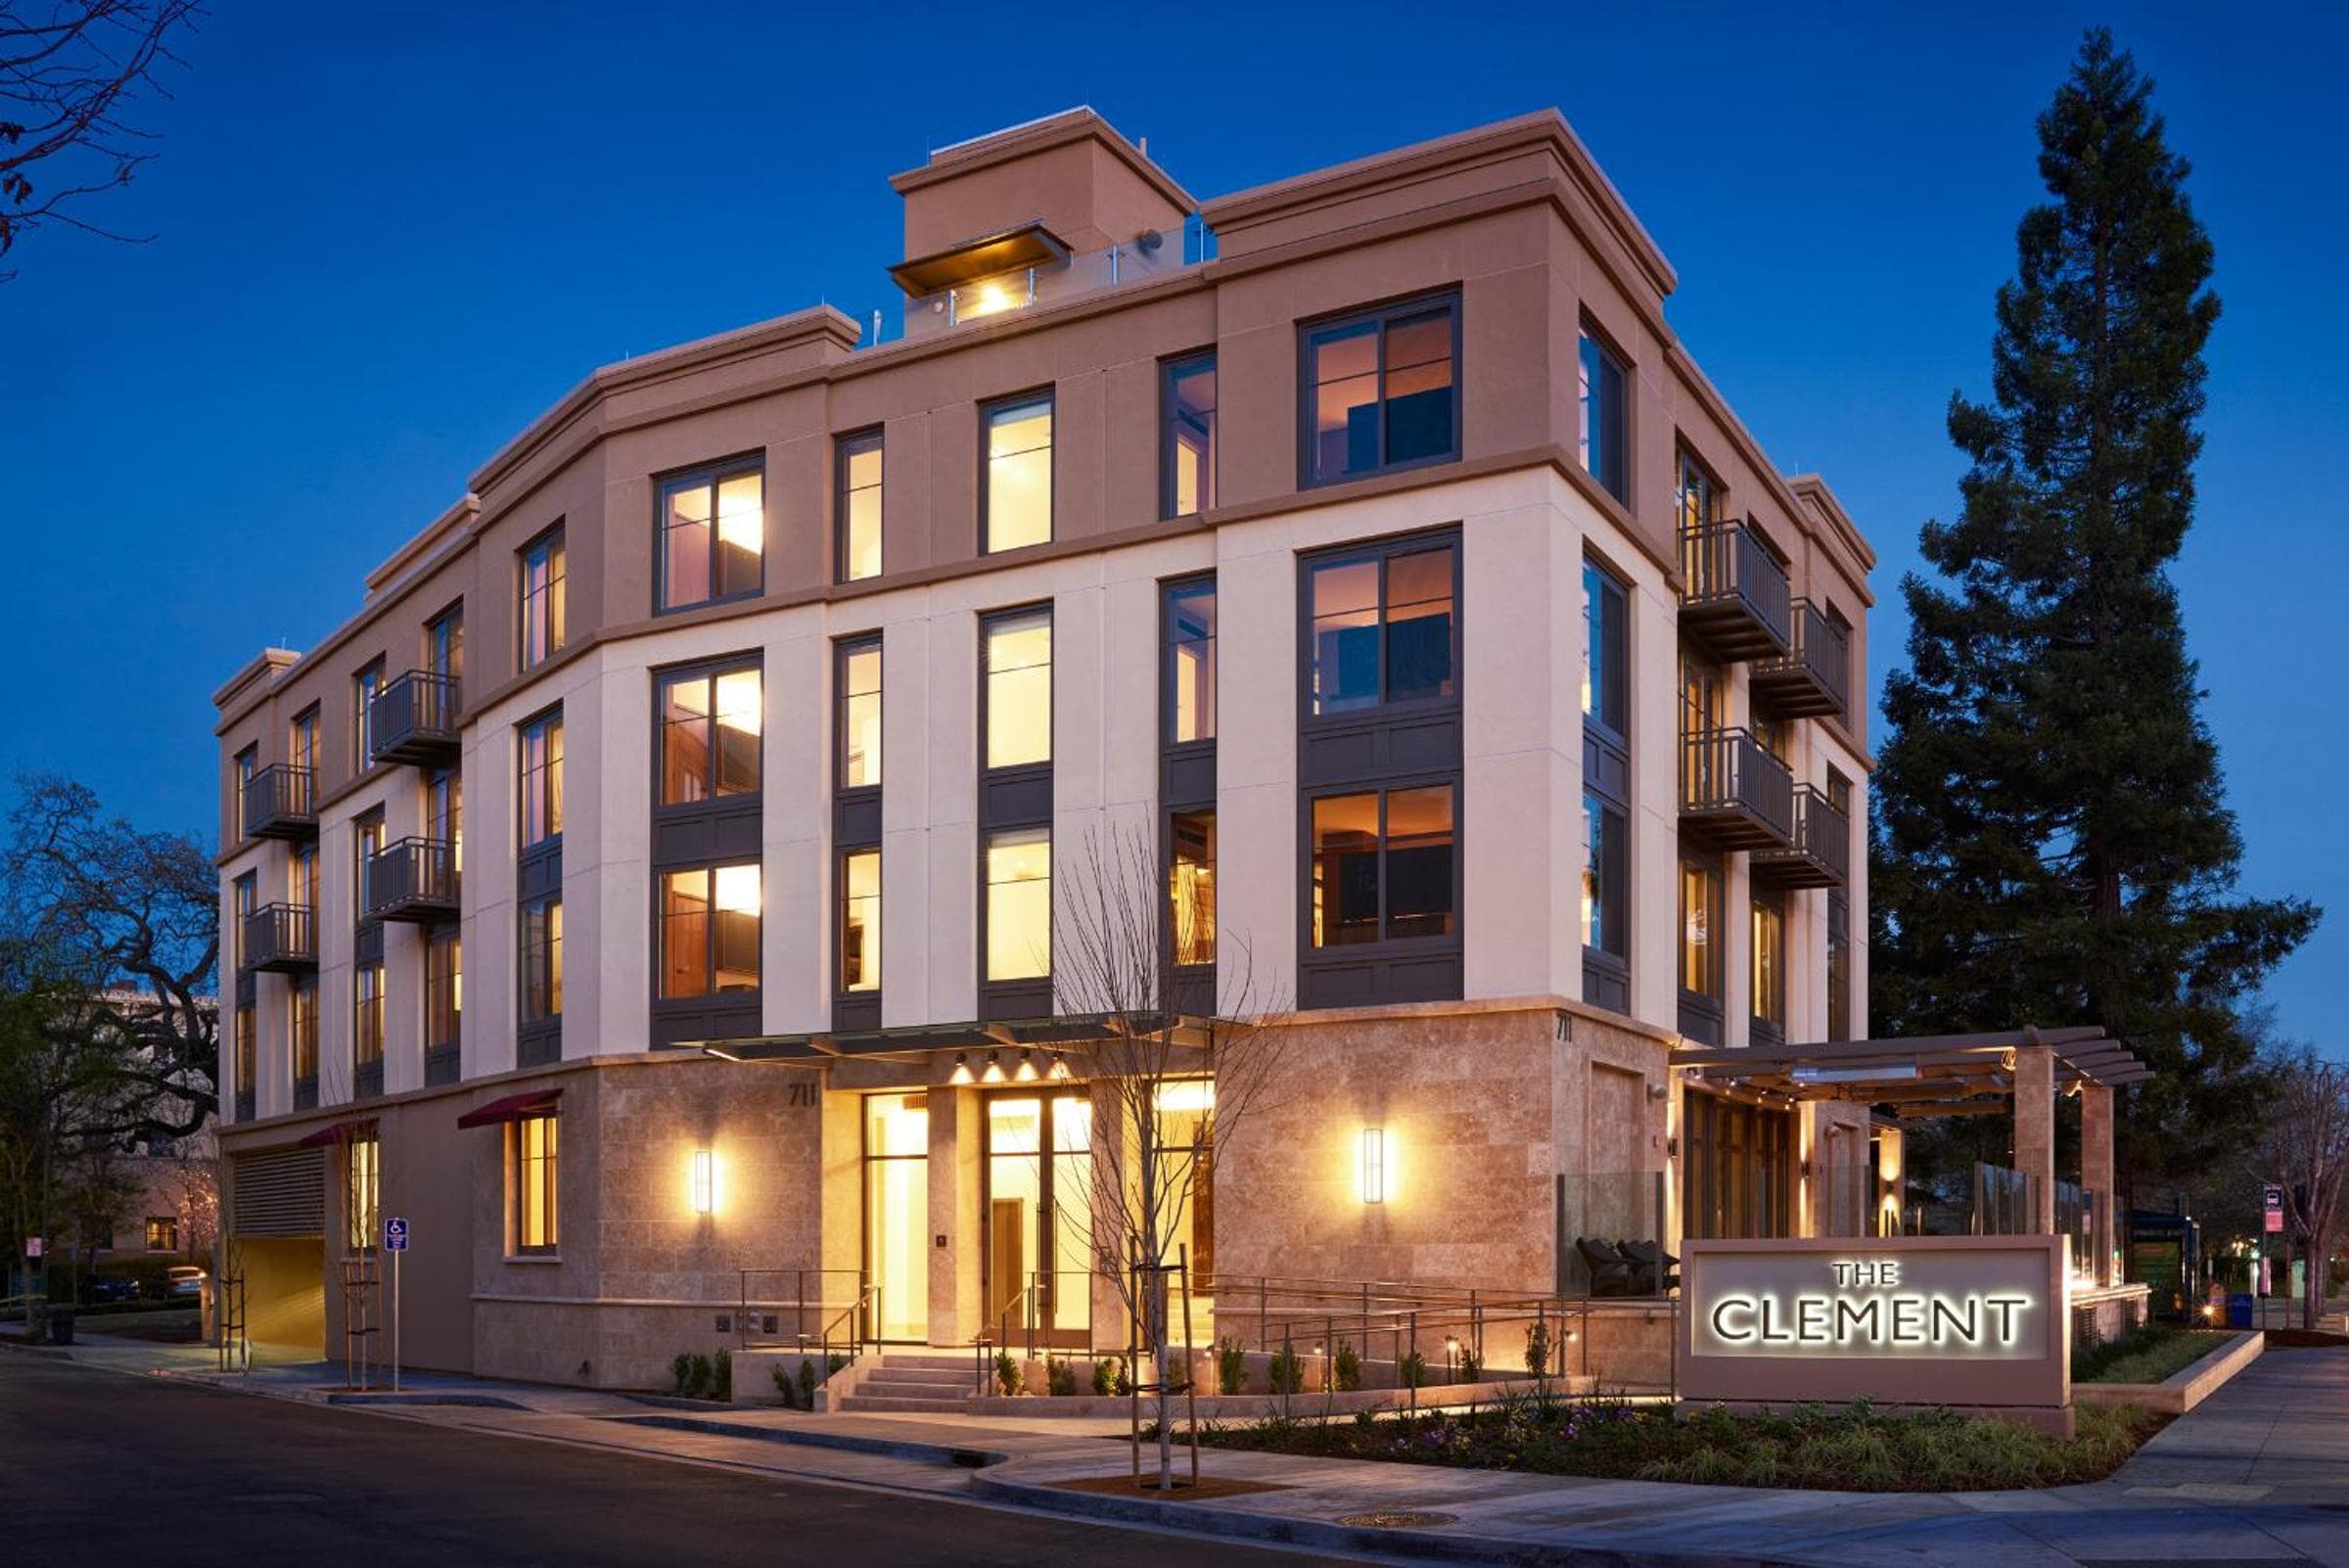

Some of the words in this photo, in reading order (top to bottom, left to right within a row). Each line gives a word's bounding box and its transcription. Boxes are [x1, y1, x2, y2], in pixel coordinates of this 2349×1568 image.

[1556, 1011, 1572, 1042] 711
[788, 1084, 815, 1107] 711
[1831, 1263, 1897, 1285] THE
[1712, 1299, 2027, 1342] CLEMENT
